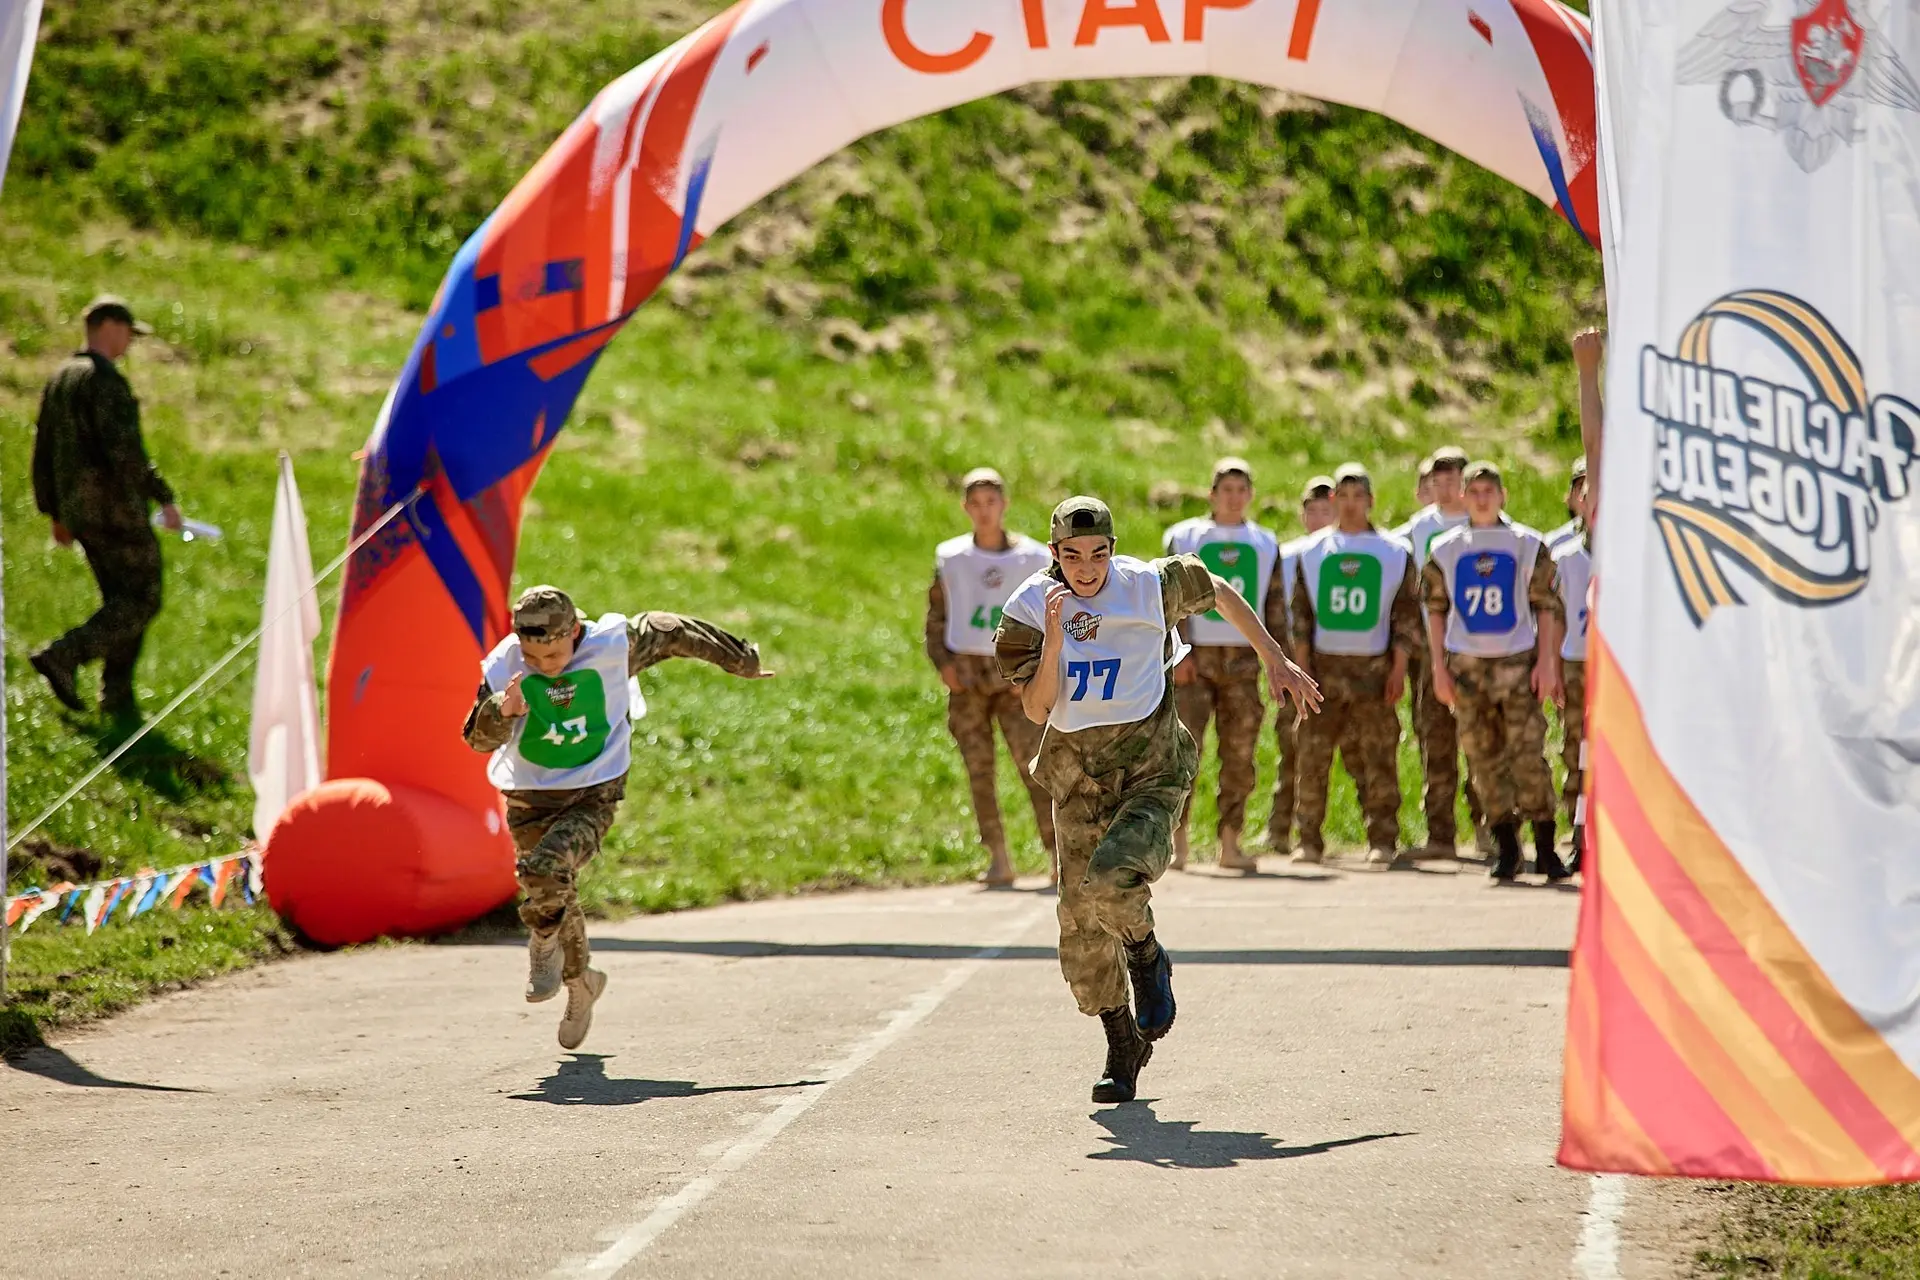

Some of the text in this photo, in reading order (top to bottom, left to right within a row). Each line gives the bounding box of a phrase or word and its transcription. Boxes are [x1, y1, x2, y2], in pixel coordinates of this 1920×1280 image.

[1330, 585, 1367, 614] 50
[1465, 585, 1503, 617] 78
[1067, 658, 1121, 701] 77
[541, 715, 588, 746] 47
